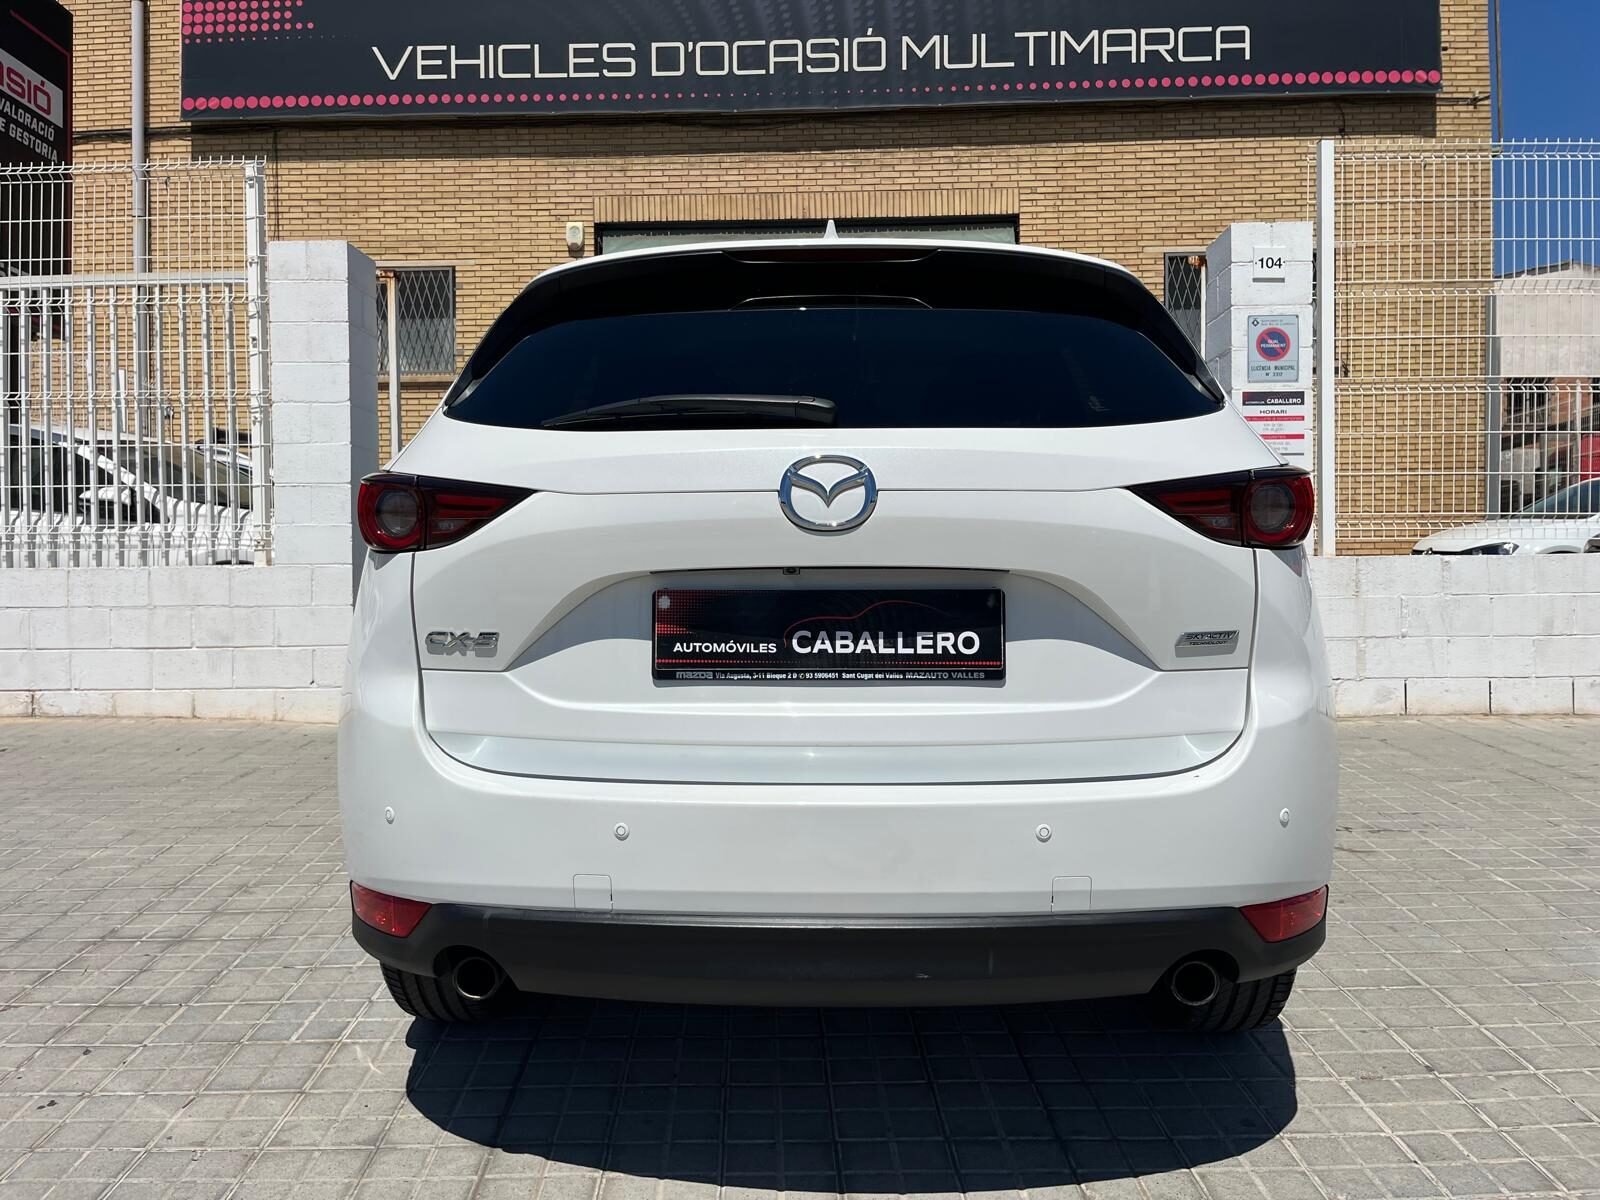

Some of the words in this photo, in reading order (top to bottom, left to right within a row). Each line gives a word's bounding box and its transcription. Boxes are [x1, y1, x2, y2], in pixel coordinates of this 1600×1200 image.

[371, 42, 637, 80] VEHICLES
[651, 28, 887, 77] D'OCASIÓ
[902, 25, 1251, 70] MULTIMARCA
[9, 123, 58, 163] GESTORIA
[425, 631, 499, 657] CX-5
[673, 640, 777, 653] AUTOMÓVILES
[791, 630, 980, 655] CABALLERO
[856, 672, 874, 680] Cugat
